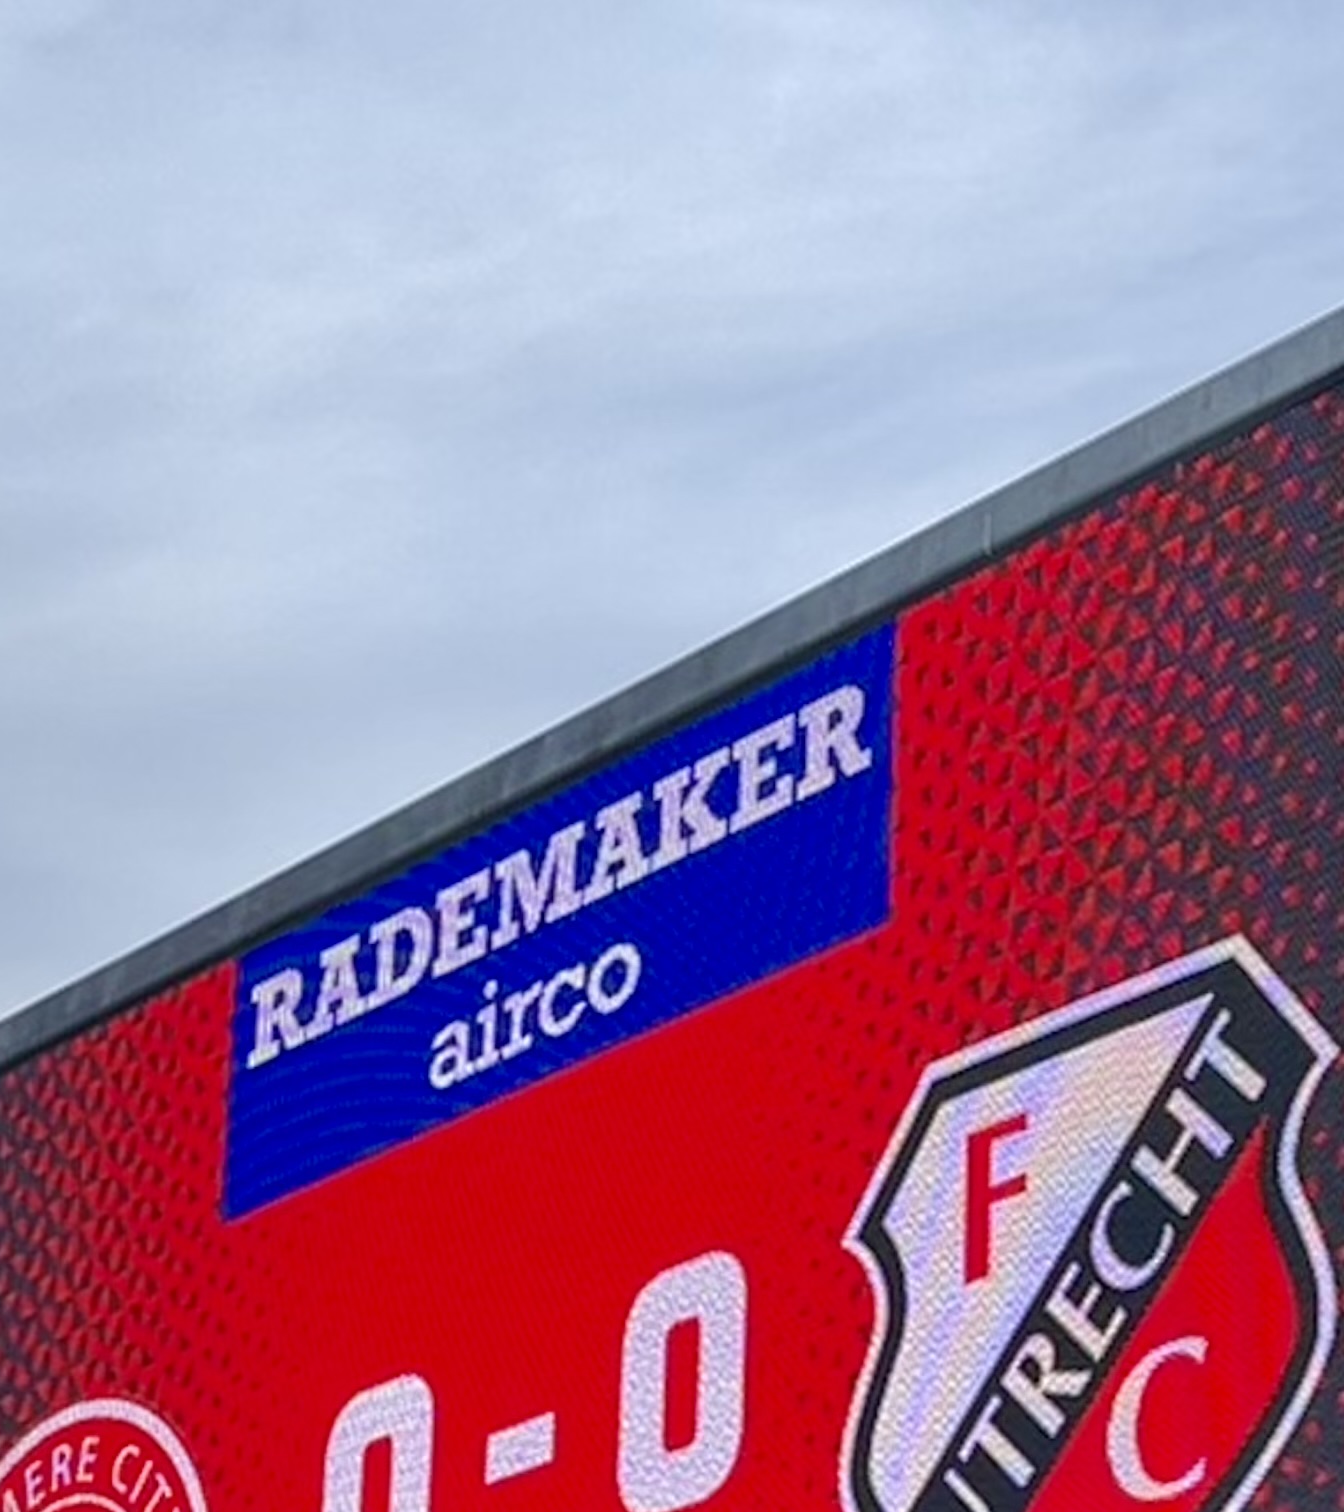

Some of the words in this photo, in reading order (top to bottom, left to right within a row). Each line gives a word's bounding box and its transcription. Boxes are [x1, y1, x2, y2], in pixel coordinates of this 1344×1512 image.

[246, 685, 873, 1069] RADEMAKER
[428, 942, 641, 1090] airco
[964, 1114, 1027, 1285] F
[1106, 1335, 1209, 1503] C
